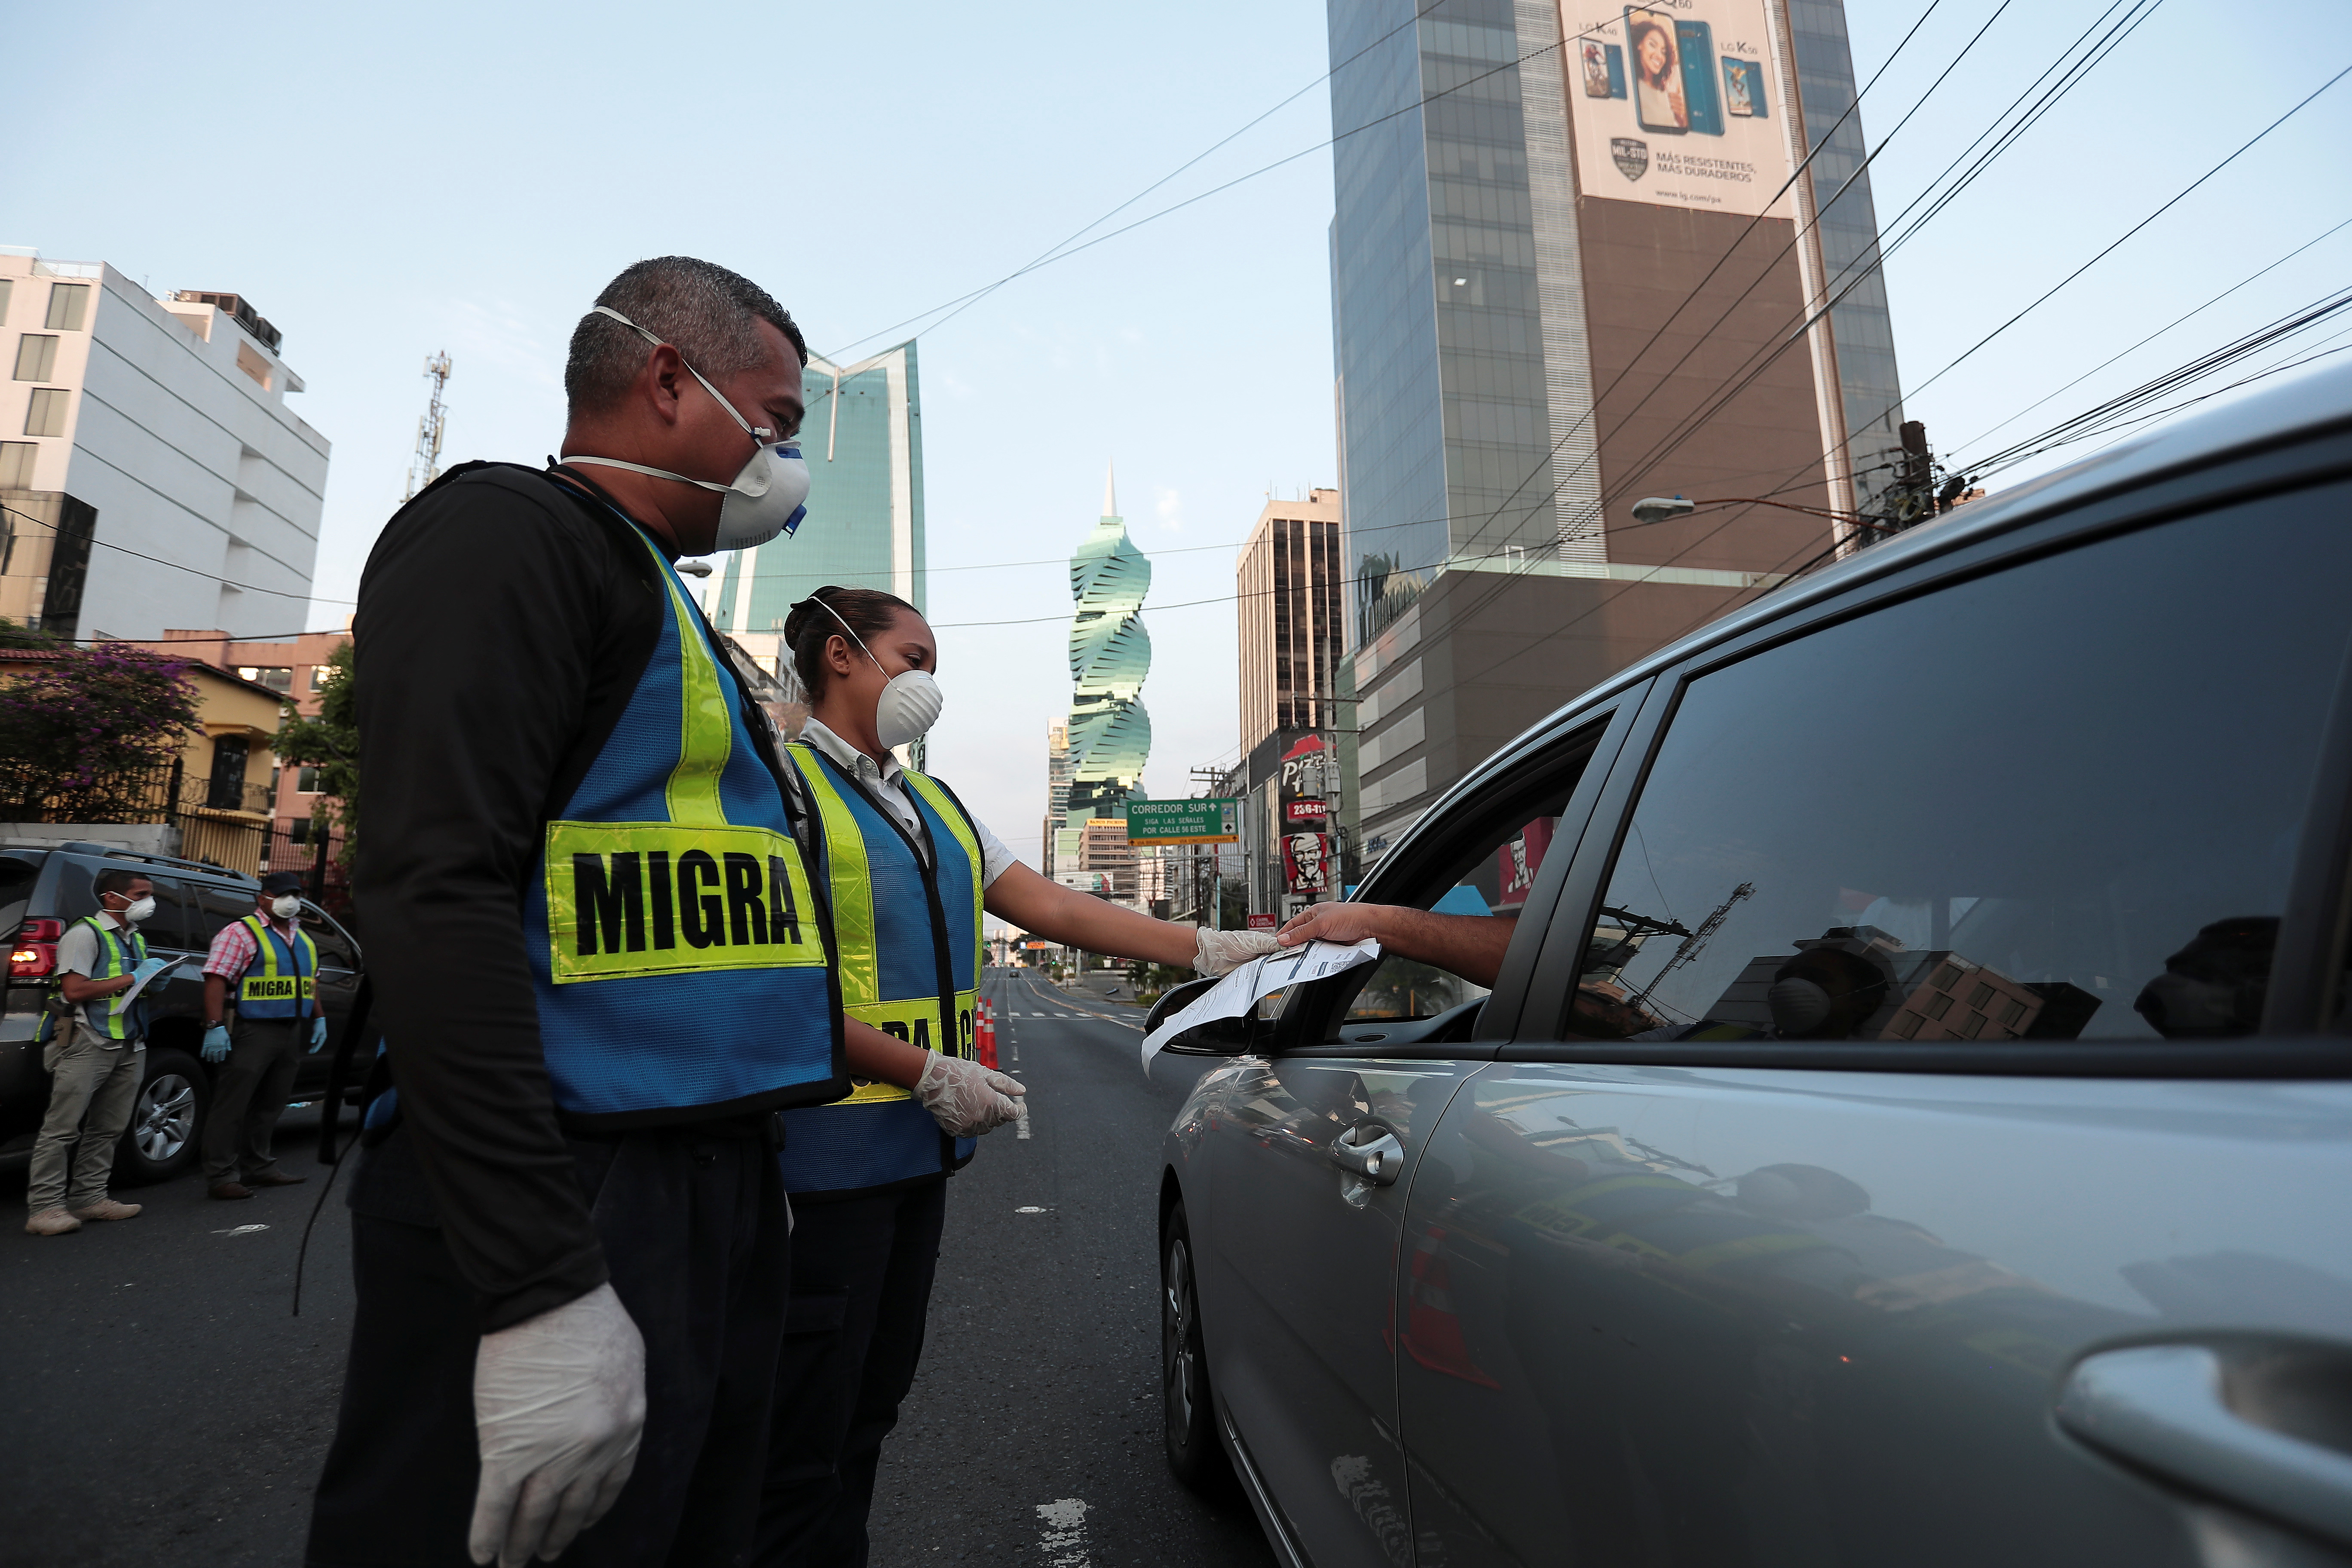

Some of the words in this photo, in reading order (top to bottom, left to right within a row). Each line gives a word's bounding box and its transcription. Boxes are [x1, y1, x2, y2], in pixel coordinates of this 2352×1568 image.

[1721, 43, 1734, 51] LG
[1656, 151, 1681, 164] MÁS
[1683, 156, 1757, 174] RESISTENTES,
[1657, 162, 1682, 174] MÁS
[1684, 166, 1752, 183] DURADEROS
[1132, 804, 1183, 815] CORREDOR
[1188, 803, 1207, 813] SUR
[573, 848, 802, 956] MIGRA
[248, 981, 292, 996] MIGRA
